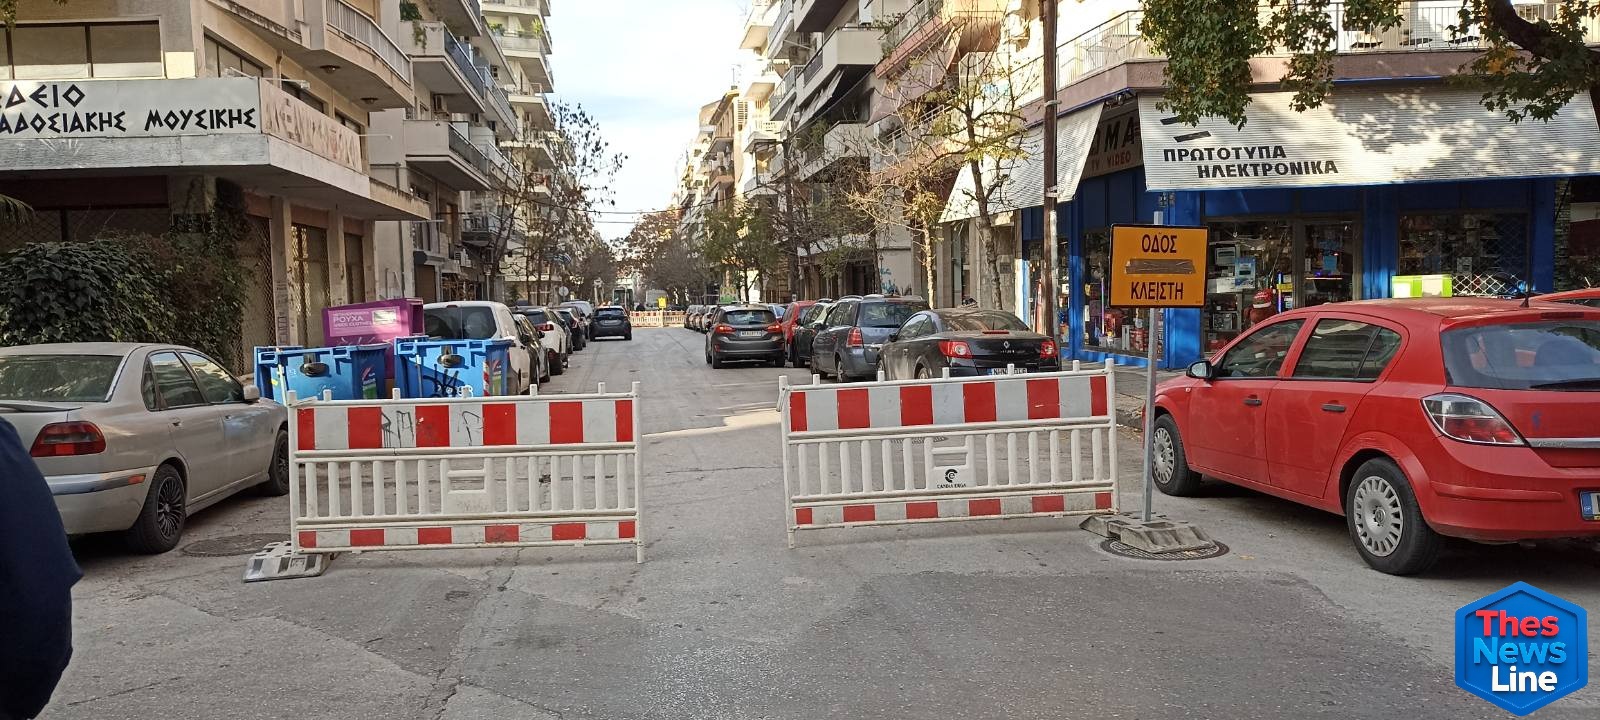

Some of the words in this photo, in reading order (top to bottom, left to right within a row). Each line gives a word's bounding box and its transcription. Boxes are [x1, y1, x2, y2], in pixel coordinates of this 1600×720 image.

[0, 84, 86, 109] ΔΕΙΟ
[144, 107, 257, 131] ΜΟΥΣΙΚΗΣ
[1107, 150, 1132, 169] VIDEO
[1163, 145, 1287, 162] ΠΡΩΤΟΤΥΠΑ
[1197, 160, 1339, 179] ΗΛΕΚΤΡΟΝΙΚΑ
[1141, 234, 1178, 253] ΟΔΟΣ
[1130, 281, 1184, 300] ΚΛΕΙΣΤΗ
[333, 315, 364, 324] ΡΟΥΧΑ
